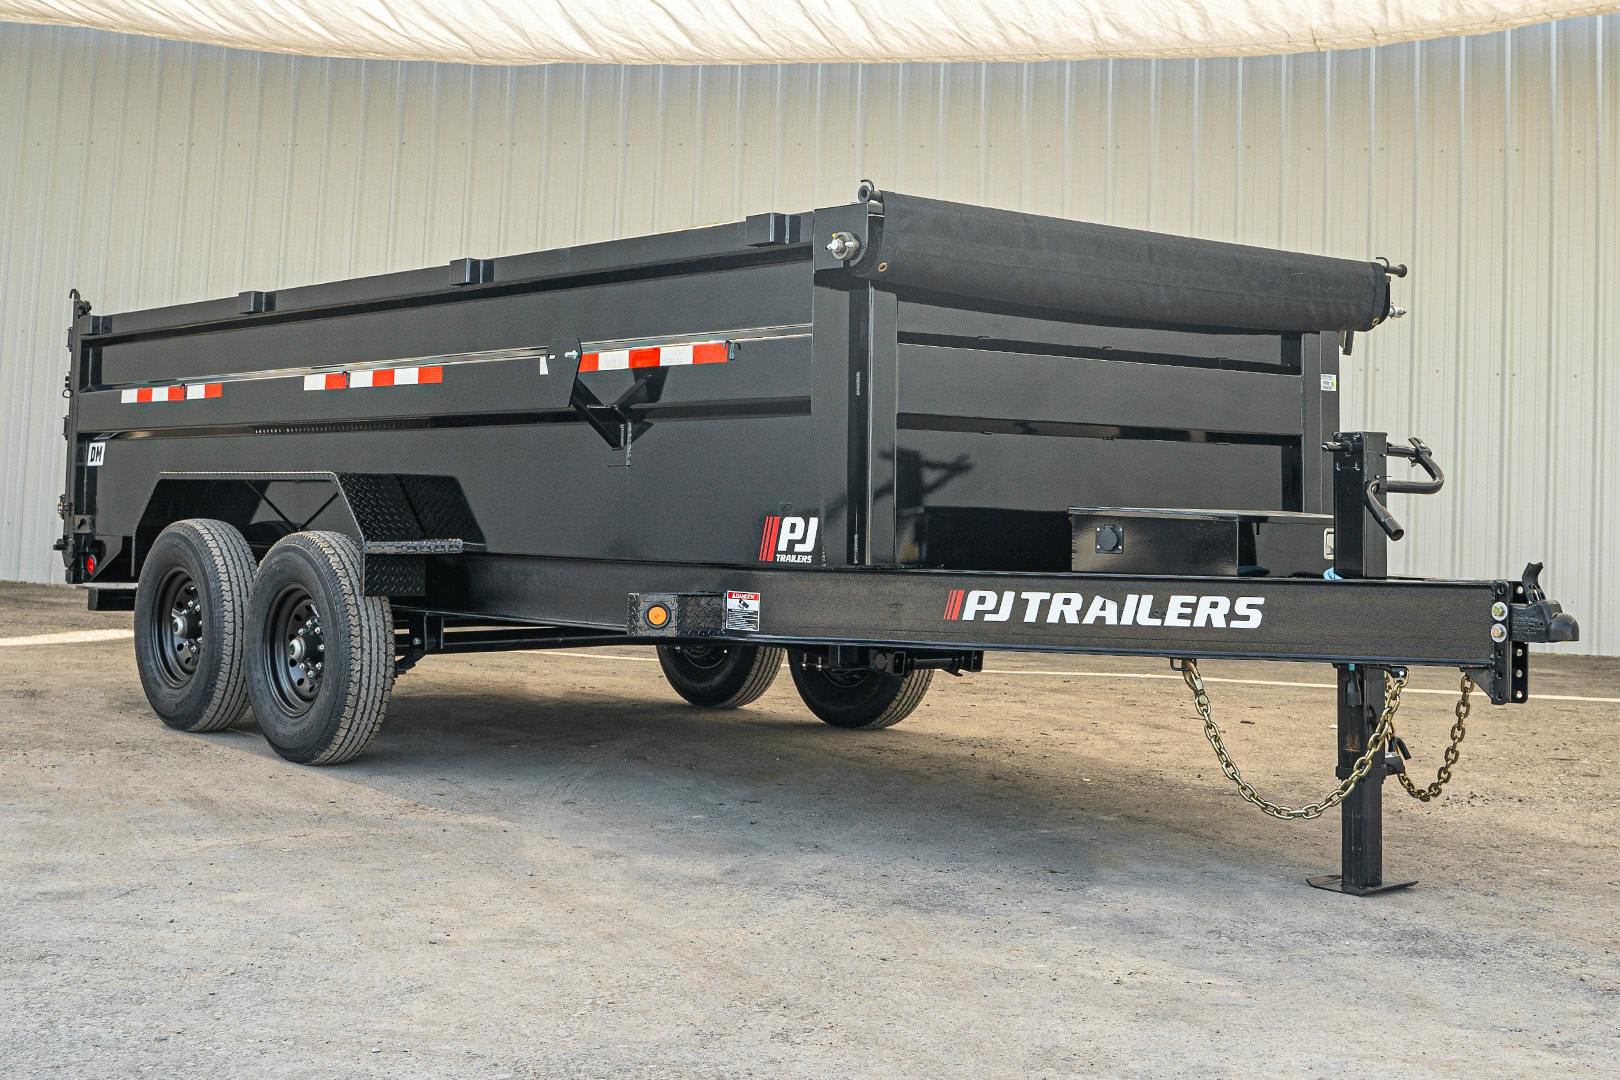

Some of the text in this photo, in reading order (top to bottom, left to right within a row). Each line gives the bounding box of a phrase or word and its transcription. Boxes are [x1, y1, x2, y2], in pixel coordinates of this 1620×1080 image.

[90, 445, 103, 462] DM
[777, 516, 819, 552] PJ
[776, 553, 812, 563] TRAILERS
[961, 590, 1266, 629] PJ TRAILERS
